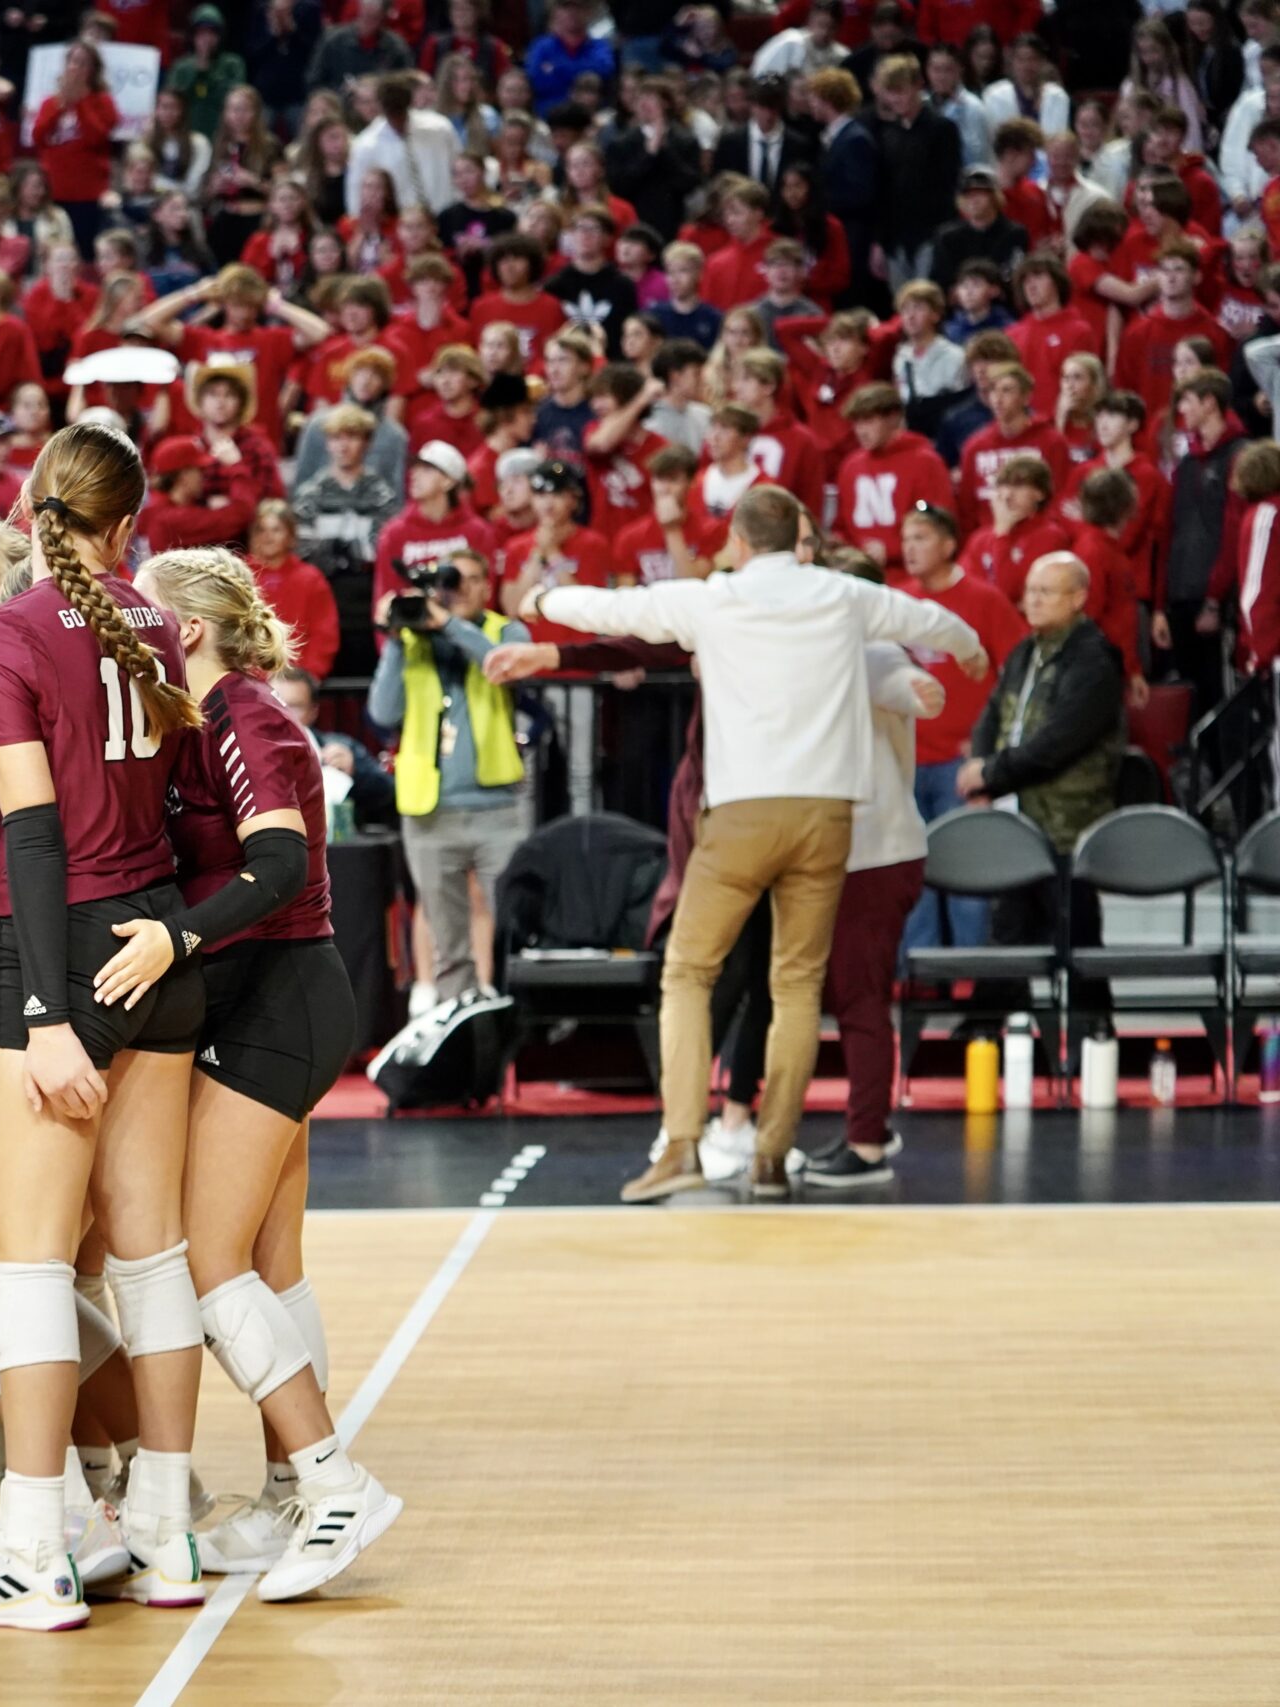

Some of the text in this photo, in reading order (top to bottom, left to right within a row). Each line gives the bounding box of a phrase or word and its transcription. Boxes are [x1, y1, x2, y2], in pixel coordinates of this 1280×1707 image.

[853, 473, 897, 528] N
[58, 606, 164, 629] GOBURG
[99, 656, 167, 761] 10
